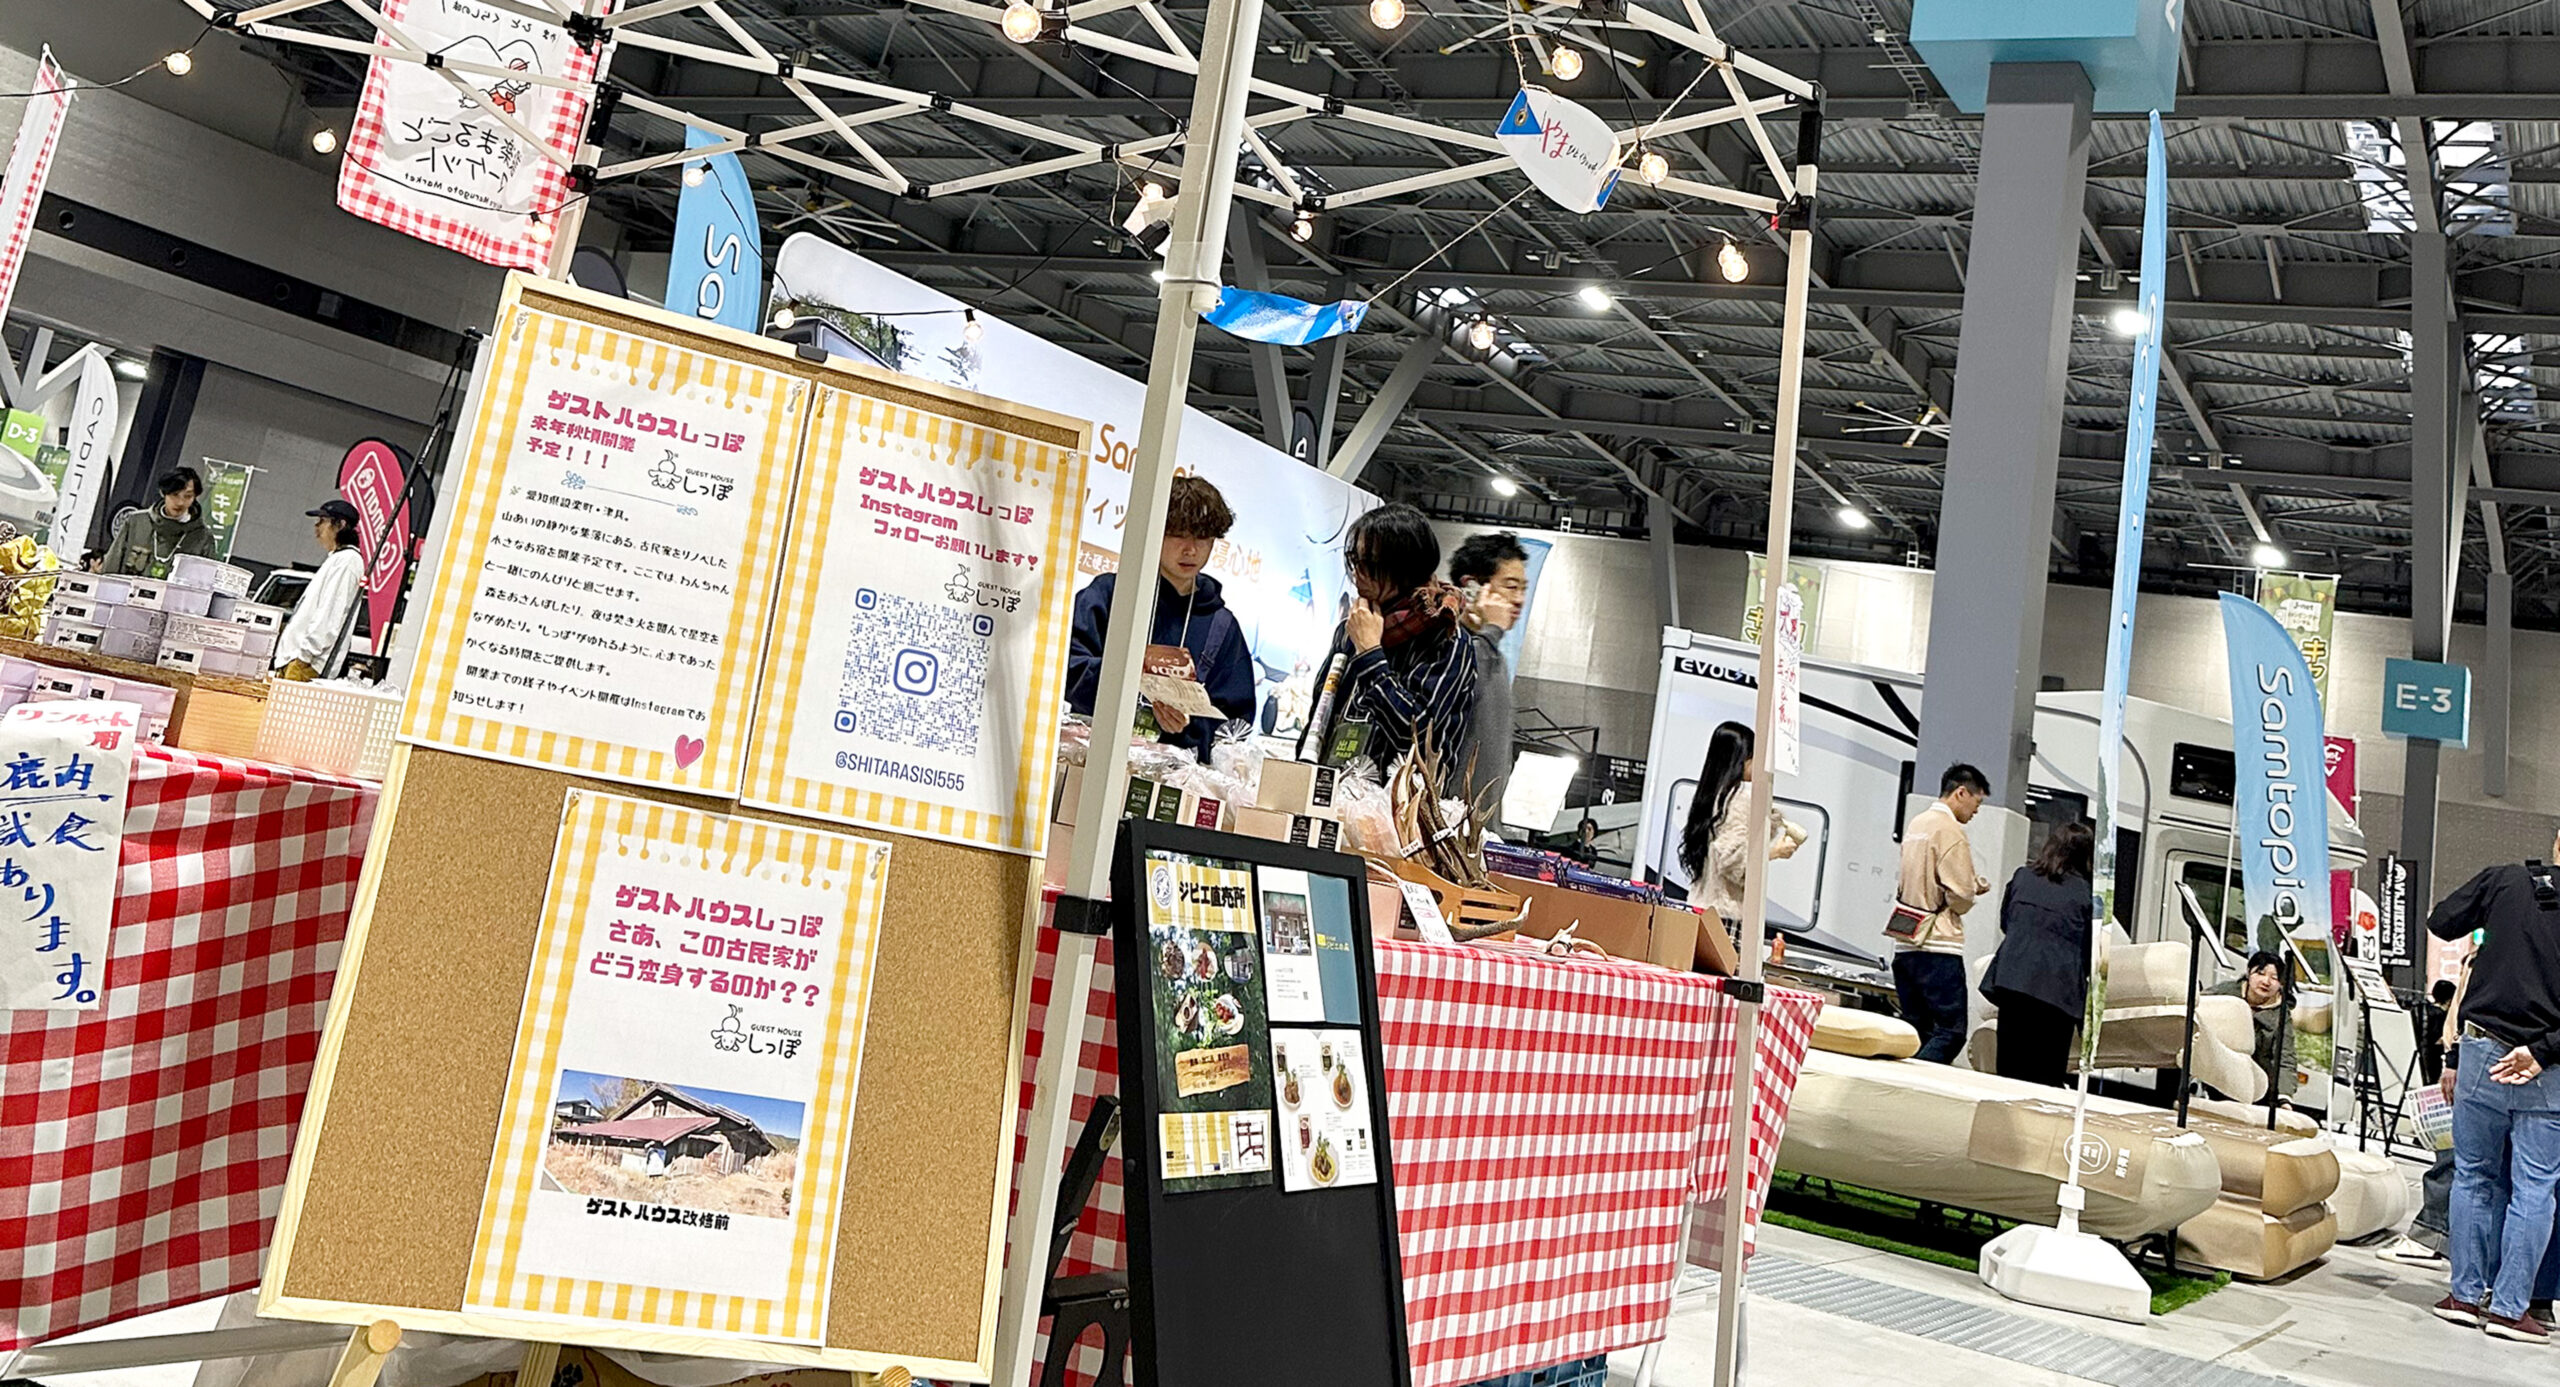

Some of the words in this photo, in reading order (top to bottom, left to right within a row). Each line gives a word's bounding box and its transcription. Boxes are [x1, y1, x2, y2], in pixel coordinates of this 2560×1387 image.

[697, 223, 742, 319] Sa
[7, 423, 39, 443] D-3
[530, 415, 636, 453] 来年秋頃開業
[547, 389, 746, 453] ゲストハウスしっぽ
[682, 476, 734, 501] しっぽ
[685, 468, 708, 479] GUEST
[710, 472, 734, 484] HOUSE
[858, 466, 1034, 525] ゲストハウスしっぽ
[859, 496, 958, 531] Instagram
[975, 589, 1022, 613] しっぽ
[977, 581, 999, 591] GUEST
[1000, 585, 1022, 597] HOUSE
[2395, 682, 2452, 715] E-3
[86, 730, 122, 751] 用
[835, 751, 965, 792] @SHITARASISI555
[2257, 664, 2306, 926] Samtopia
[615, 884, 823, 938] ゲストハウスしっぽ
[1179, 881, 1246, 909] ジビエ直売所
[608, 919, 818, 971] さあ、この古民家が
[747, 1033, 802, 1059] しっぽ
[750, 1023, 776, 1035] GUEST
[777, 1027, 802, 1038] HOUSE
[586, 1197, 730, 1232] ゲストハウス改修前
